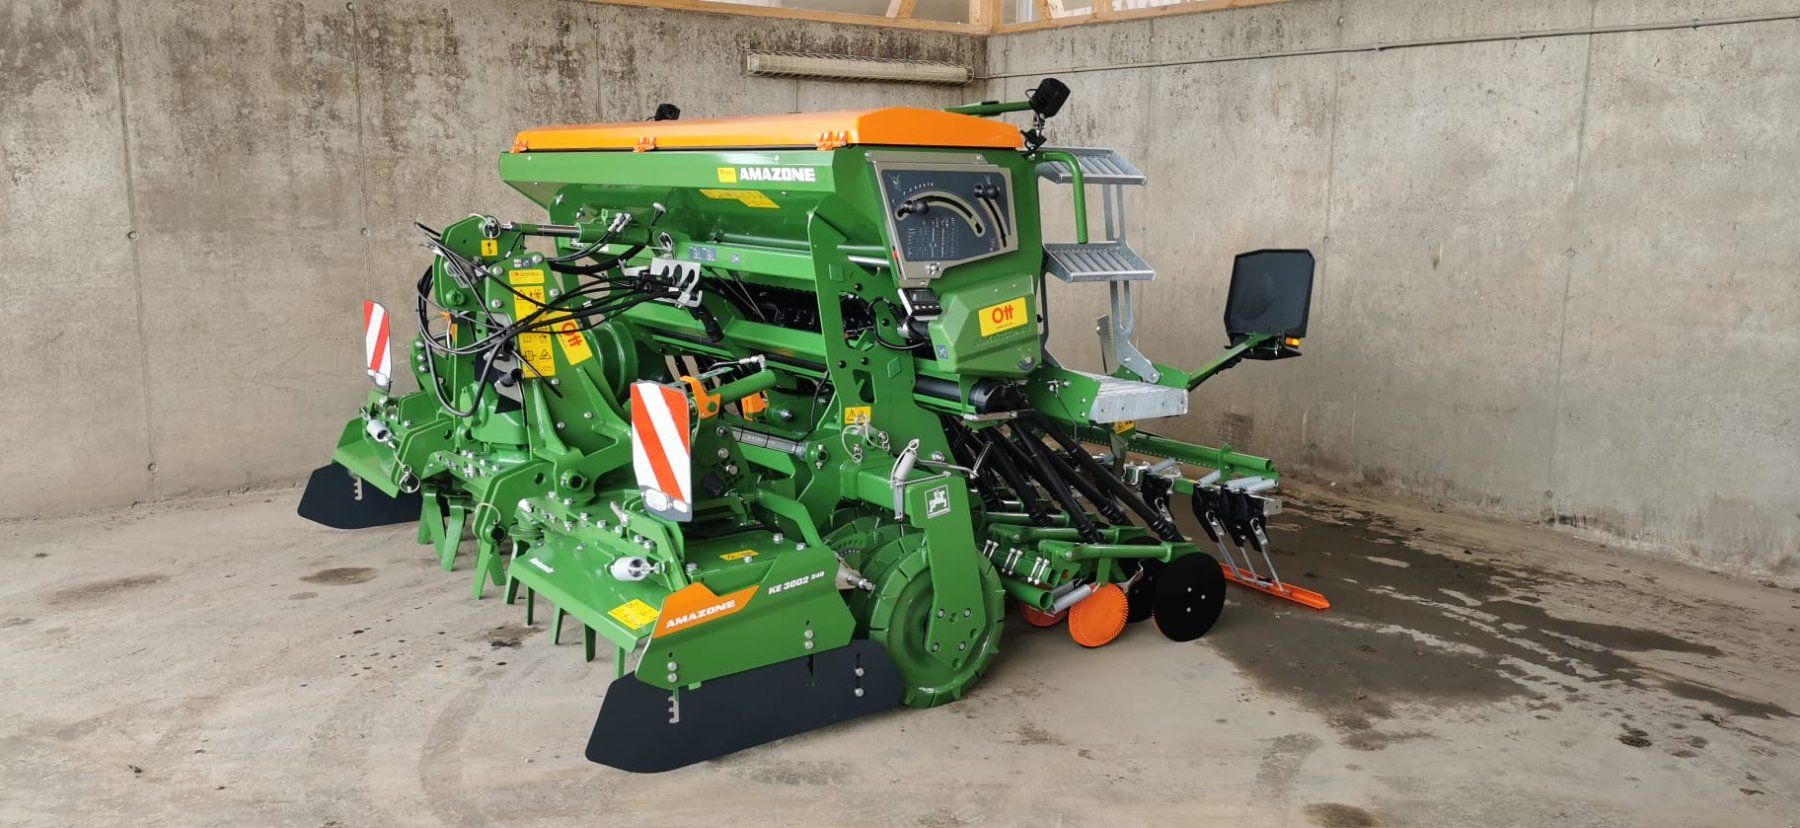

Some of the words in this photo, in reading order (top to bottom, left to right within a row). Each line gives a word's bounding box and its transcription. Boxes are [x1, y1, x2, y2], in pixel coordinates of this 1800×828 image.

[740, 167, 816, 182] AMAZONE
[992, 304, 1014, 324] Ott
[768, 584, 782, 594] KE
[783, 576, 809, 590] 3002
[665, 600, 736, 629] AMAZONE
